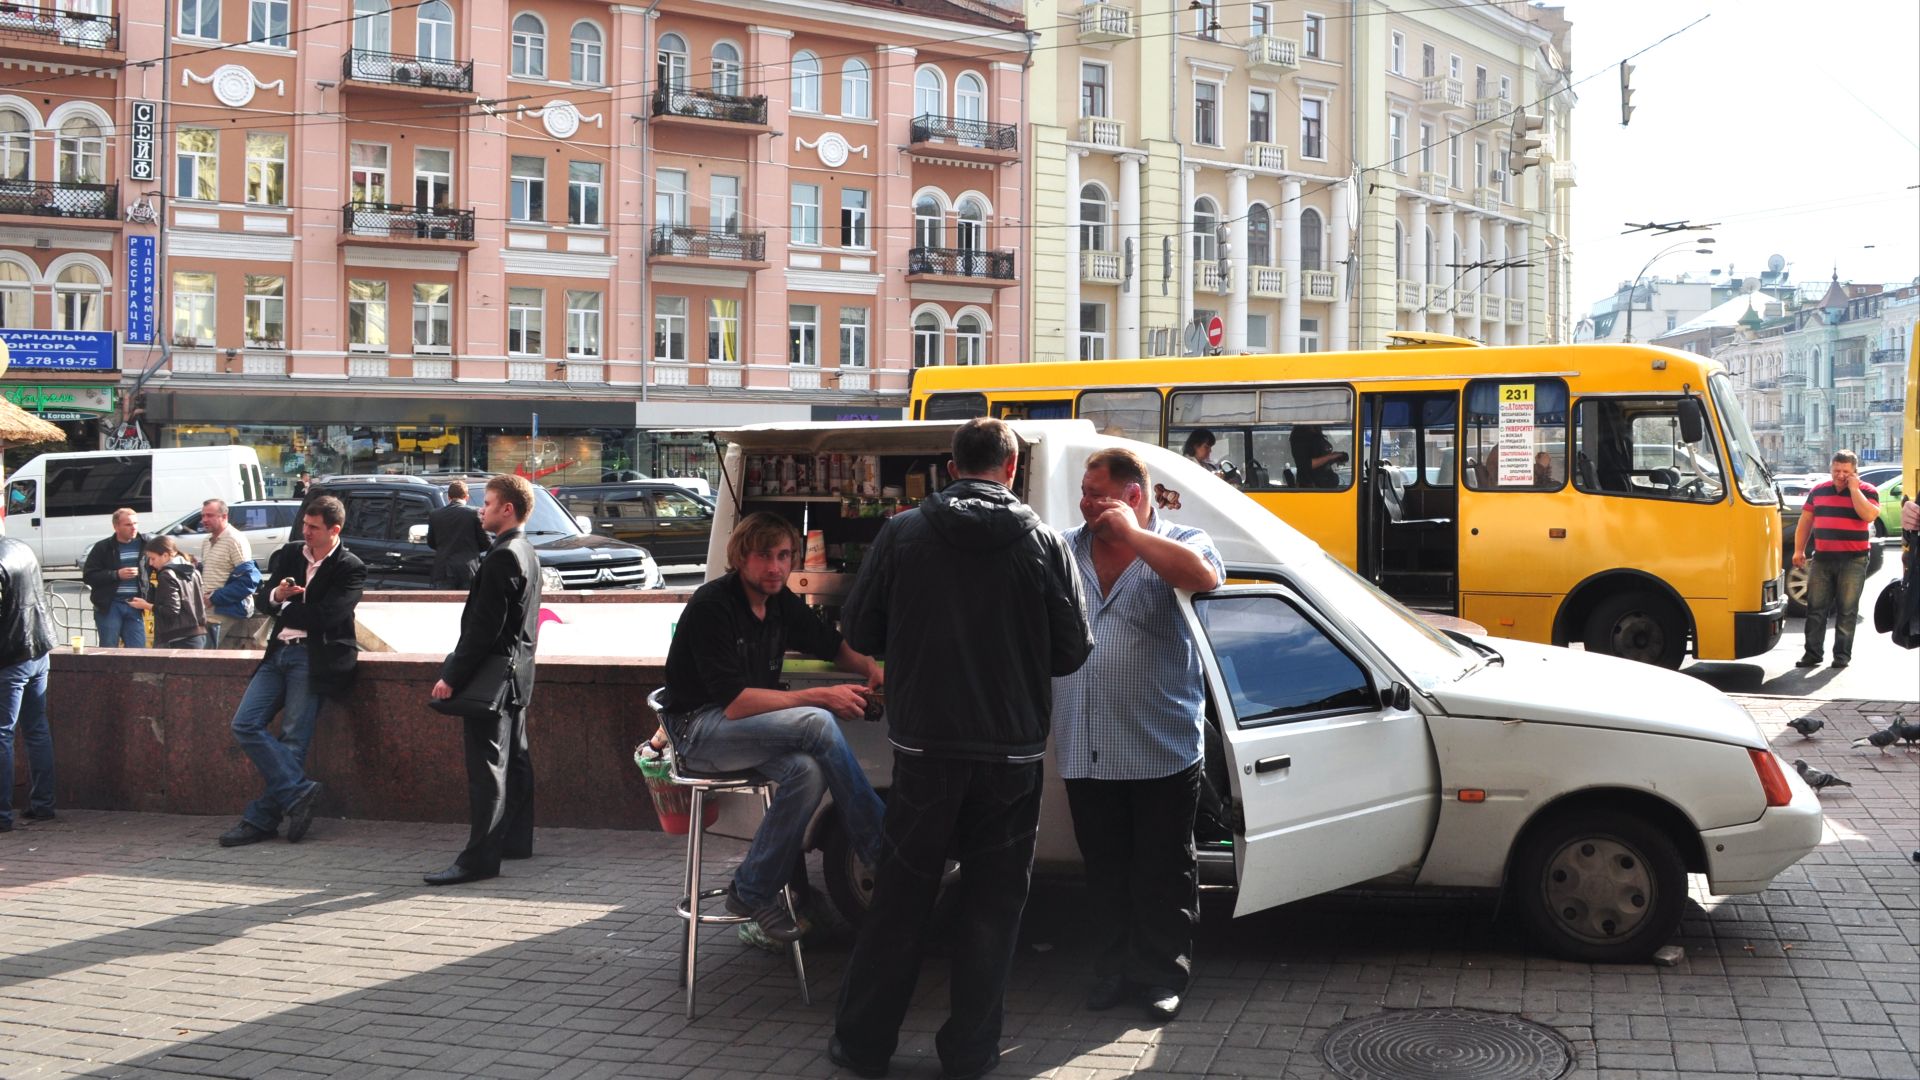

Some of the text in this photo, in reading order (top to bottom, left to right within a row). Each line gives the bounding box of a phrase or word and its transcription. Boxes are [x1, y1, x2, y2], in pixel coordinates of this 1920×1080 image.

[135, 105, 151, 177] СЕЙФ
[130, 237, 138, 340] РЕЄСТРАЦІЯ
[144, 238, 152, 341] ПІДПРИЄМСТВ
[0, 333, 98, 342] ТАРІАЛЬНА
[7, 342, 76, 350] ОНТОРА
[25, 356, 97, 366] 278-19-75
[1505, 389, 1528, 400] 231
